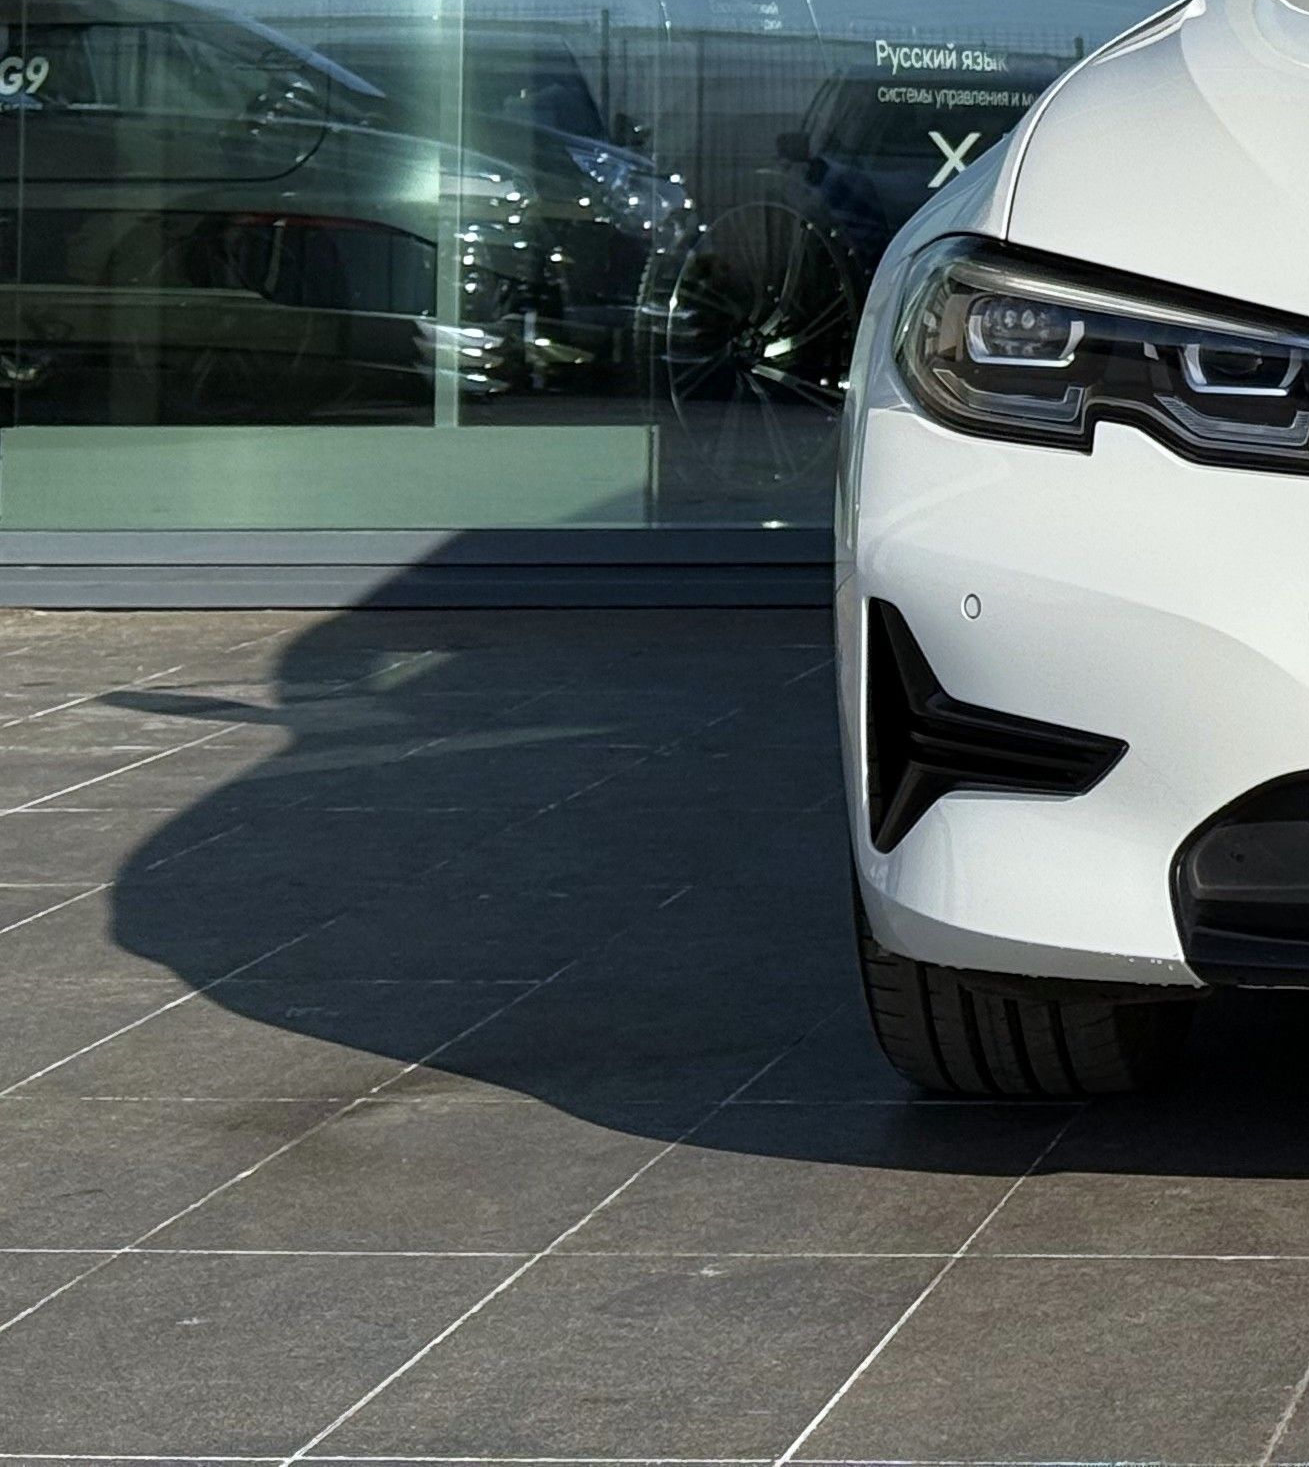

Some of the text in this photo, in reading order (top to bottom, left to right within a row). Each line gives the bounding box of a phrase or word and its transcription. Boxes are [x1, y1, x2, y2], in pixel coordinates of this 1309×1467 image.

[875, 39, 1009, 75] Русский язык
[0, 56, 49, 95] G9
[877, 86, 934, 104] системы
[934, 89, 1009, 110] управления
[1011, 92, 1020, 107] и
